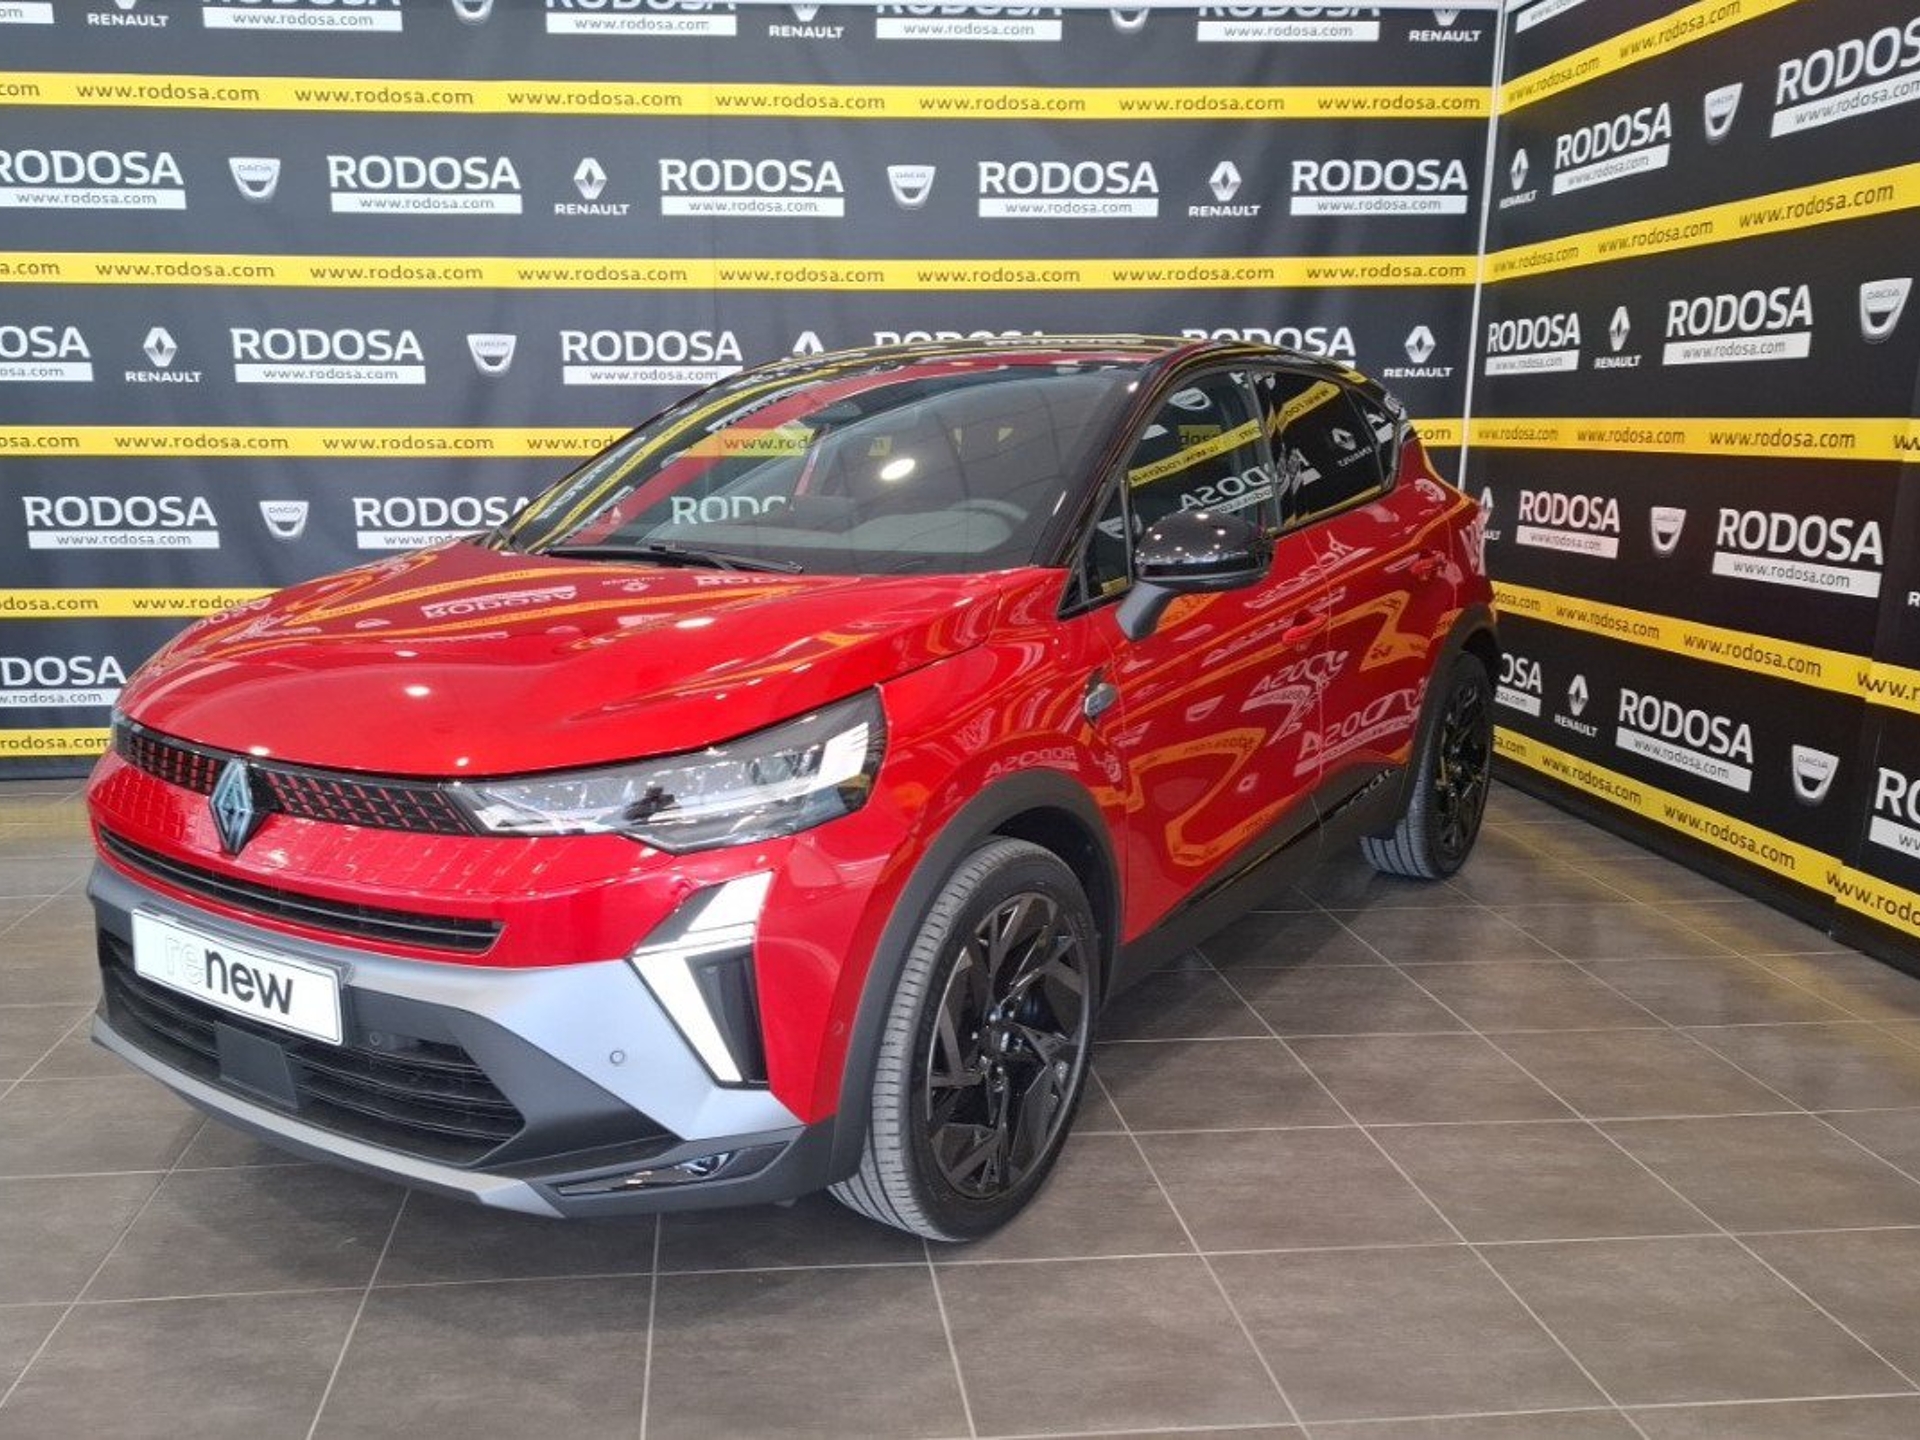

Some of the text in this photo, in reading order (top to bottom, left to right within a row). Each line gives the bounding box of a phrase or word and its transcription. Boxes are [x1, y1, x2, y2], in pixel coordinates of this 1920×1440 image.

[87, 12, 169, 28] RENAULT
[233, 12, 373, 27] www.rodosa.com
[575, 17, 708, 31] www.rodosa.com
[904, 21, 1035, 36] www.rodosa.com
[769, 25, 844, 38] RENAULT
[1224, 23, 1353, 38] www.rodosa.com
[1409, 29, 1481, 42] RENAULT
[1508, 1, 1741, 103] www.rodosa.com www.rodosa.com
[76, 83, 1480, 112] www.rodosa.com www.rodosa.com www.rodosa.com www.rodosa.com www.rodosa.com www.rodosa.com www.rodosa.com
[1555, 102, 1672, 170] RODOSA
[326, 155, 522, 190] RODOSA
[659, 159, 844, 193] RODOSA
[978, 161, 1159, 194] RODOSA
[1291, 159, 1468, 193] RODOSA
[16, 191, 157, 205] www.rodosa.com
[359, 197, 495, 210] www.rodosa.com
[689, 199, 818, 213] www.rodosa.com
[1005, 200, 1132, 214] www.rodosa.com
[1317, 198, 1441, 211] www.rodosa.com
[555, 203, 630, 216] RENAULT
[1188, 205, 1261, 217] RENAULT
[1493, 184, 1894, 273] www.rodosa.com www.rodosa.com www.rodosa.com
[95, 260, 1466, 284] www.rodosa.com www.rodosa.com www.rodosa.com www.rodosa.com www.rodosa.com www.rodosa.com www.rodosa.com
[1666, 285, 1813, 337] RODOSA
[1487, 312, 1580, 353] RODOSA
[229, 328, 425, 361] RODOSA
[560, 330, 743, 363] RODOSA
[1683, 340, 1786, 360] www.rodosa.com
[1384, 367, 1453, 378] RENAULT
[1594, 355, 1642, 369] RENAULT
[125, 371, 201, 384] RENAULT
[263, 367, 399, 380] www.rodosa.com
[590, 369, 719, 382] www.rodosa.com
[115, 433, 289, 450] www.rodosa.com
[323, 434, 494, 450] www.rodosa.com
[1478, 426, 1855, 448] www.rodosa.com www.rodosa.com www.rodosa.com
[22, 496, 218, 527] RODOSA
[268, 506, 301, 514] DACIA
[1518, 490, 1620, 532] RODOSA
[57, 534, 192, 546] www.rodosa.com
[1717, 508, 1883, 566] RODOSA
[1734, 561, 1850, 588] www.rodosa.com
[1556, 605, 1660, 639] www.rodosa.com
[1683, 633, 1822, 677] www.rodosa.com
[1554, 714, 1598, 738] RENAULT
[1619, 688, 1753, 764] RODOSA
[1634, 739, 1729, 779] www.rodosa.com
[1542, 755, 1642, 804] www.rodosa.com
[1663, 804, 1796, 870] www.rodosa.com
